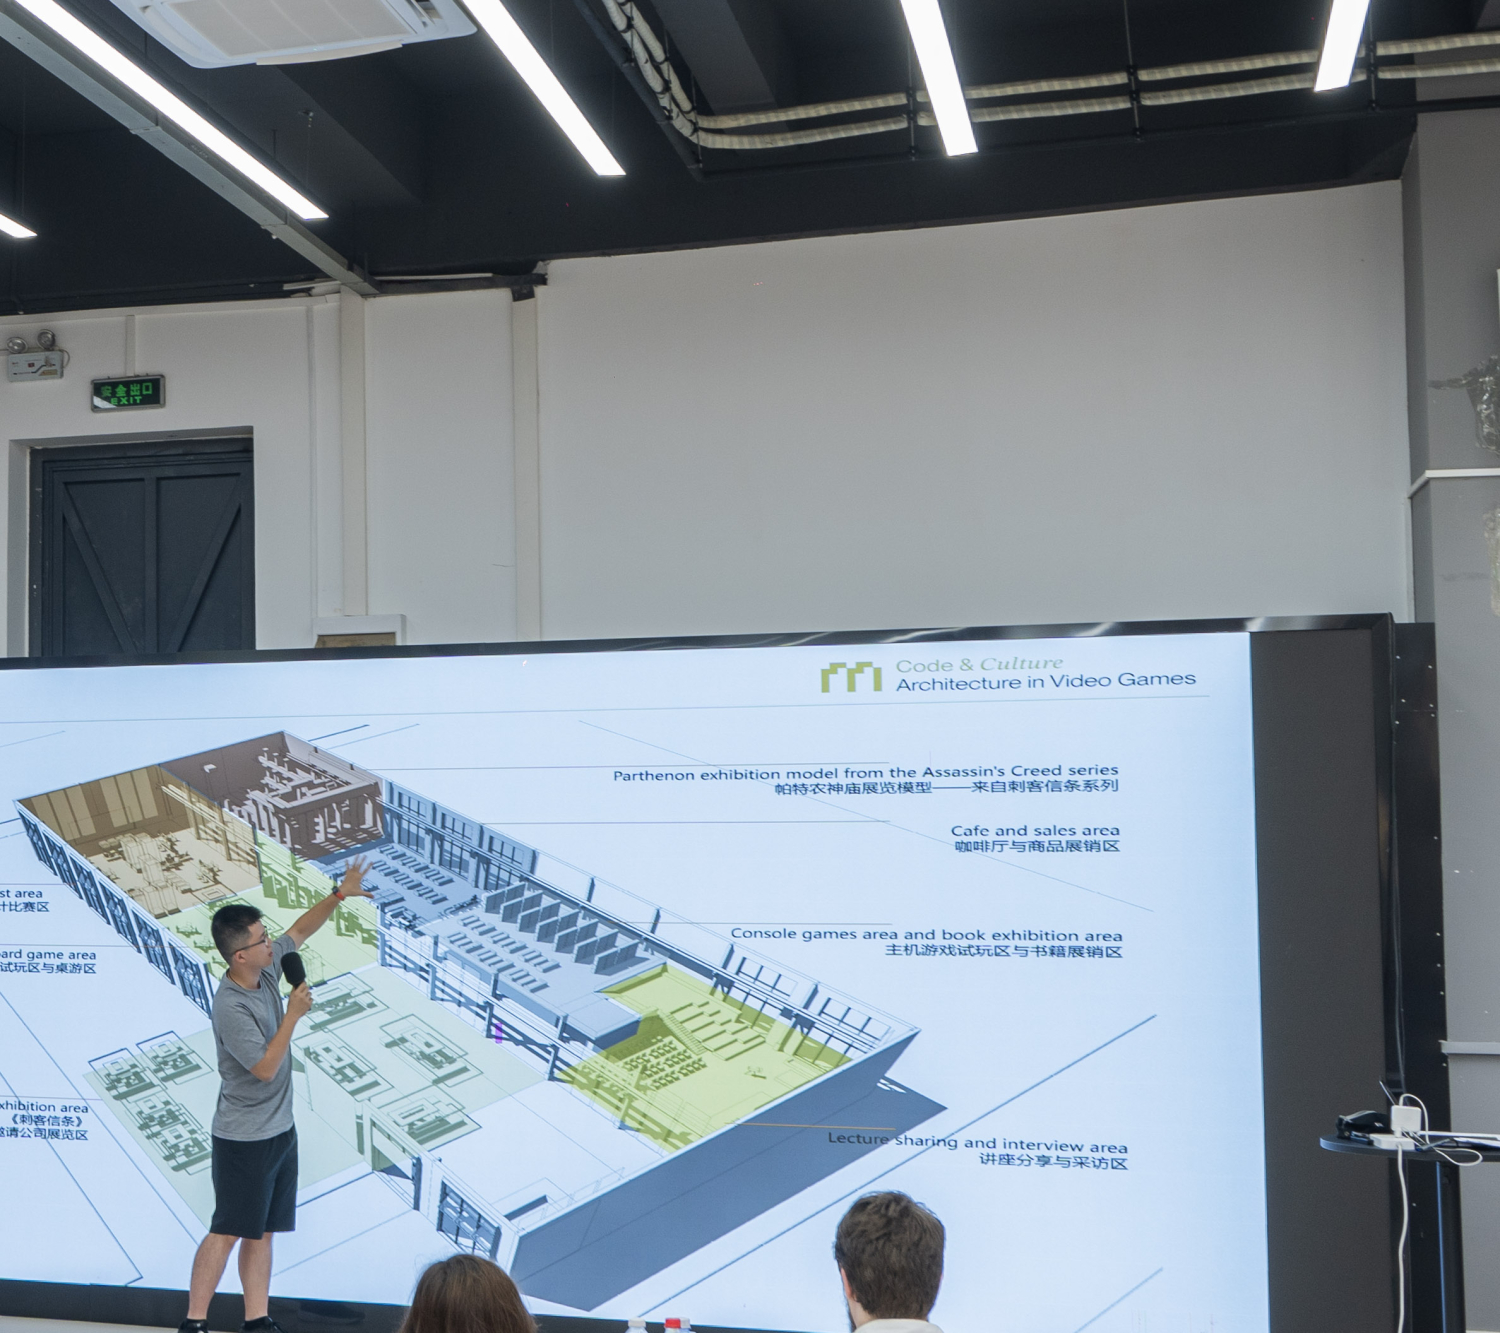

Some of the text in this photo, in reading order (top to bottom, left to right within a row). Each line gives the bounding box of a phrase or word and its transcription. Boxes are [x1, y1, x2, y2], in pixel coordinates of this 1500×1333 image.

[100, 382, 153, 398] 安全出口
[110, 396, 143, 405] EXIT
[896, 656, 1064, 674] Code & Culture
[896, 672, 1197, 692] Architecture in Video Games
[613, 764, 1119, 781] Parthenon exhibition model from the Assassin's Creed series
[951, 825, 1120, 837] Cafe and sales area
[955, 840, 1121, 853] 咖啡厅与商品展销区
[14, 890, 43, 899] area
[731, 927, 1123, 942] Console games area and book exhibition area
[26, 950, 64, 961] game
[68, 950, 97, 960] area
[885, 943, 1123, 958] 主机游戏试玩区与书籍展销区
[60, 1103, 89, 1113] area
[828, 1131, 1128, 1154] Lecture sharing and interview area
[979, 1153, 1129, 1170] 讲座分享与采访区
